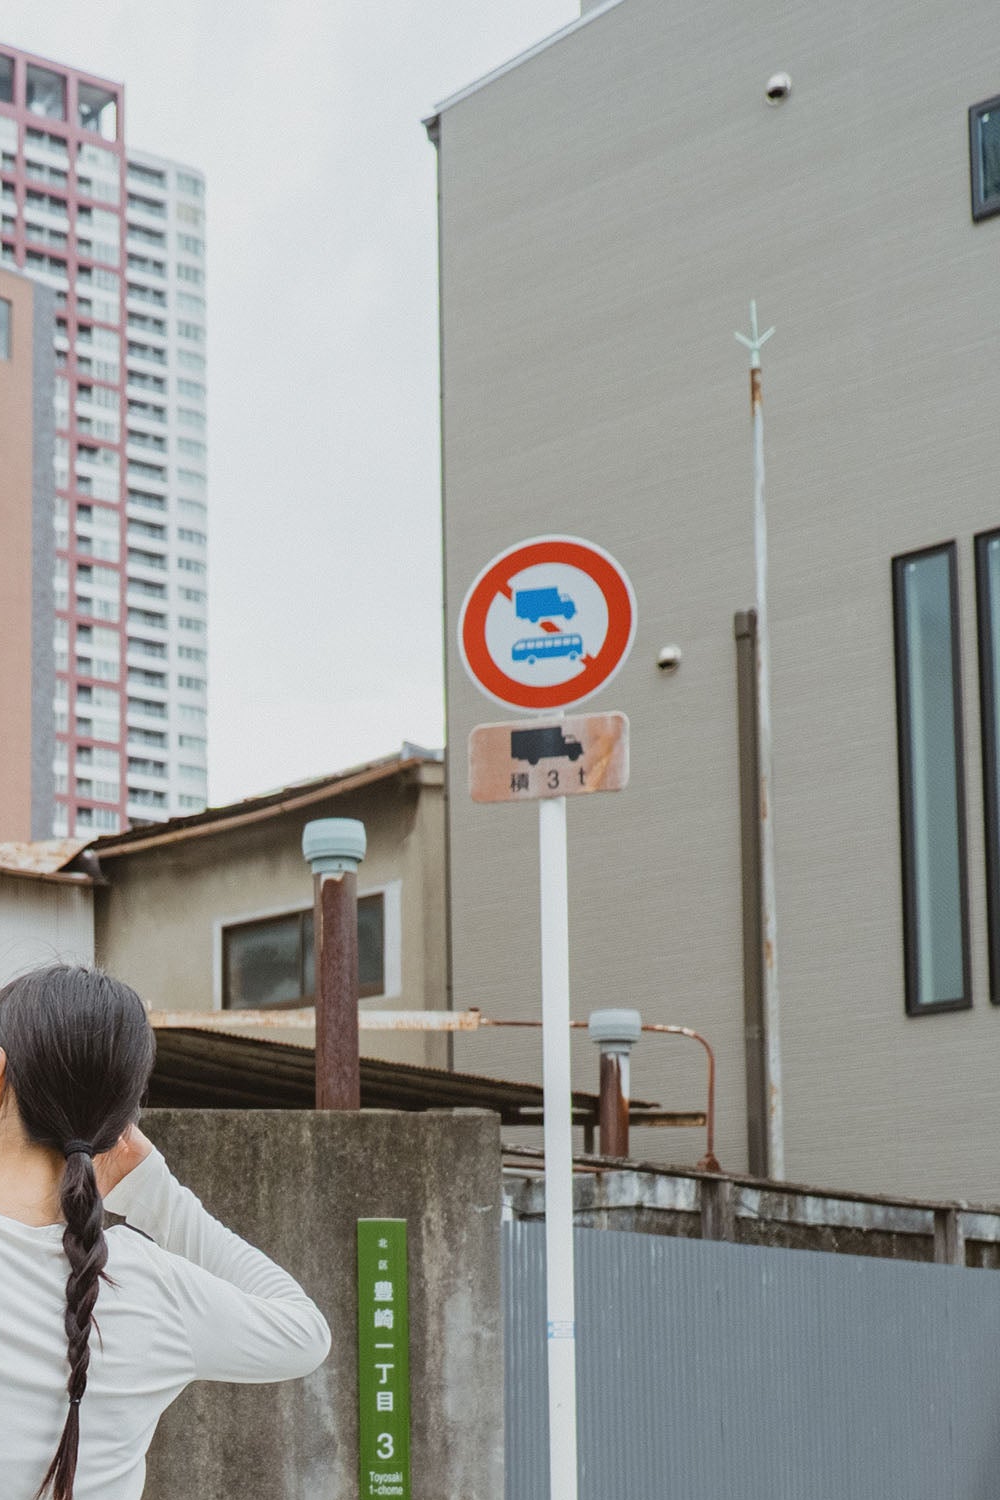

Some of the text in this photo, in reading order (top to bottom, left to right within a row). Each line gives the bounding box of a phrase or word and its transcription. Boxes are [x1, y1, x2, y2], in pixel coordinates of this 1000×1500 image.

[377, 1433, 394, 1459] 3
[369, 1471, 403, 1484] Toyosaki
[369, 1485, 403, 1495] 1-chome
